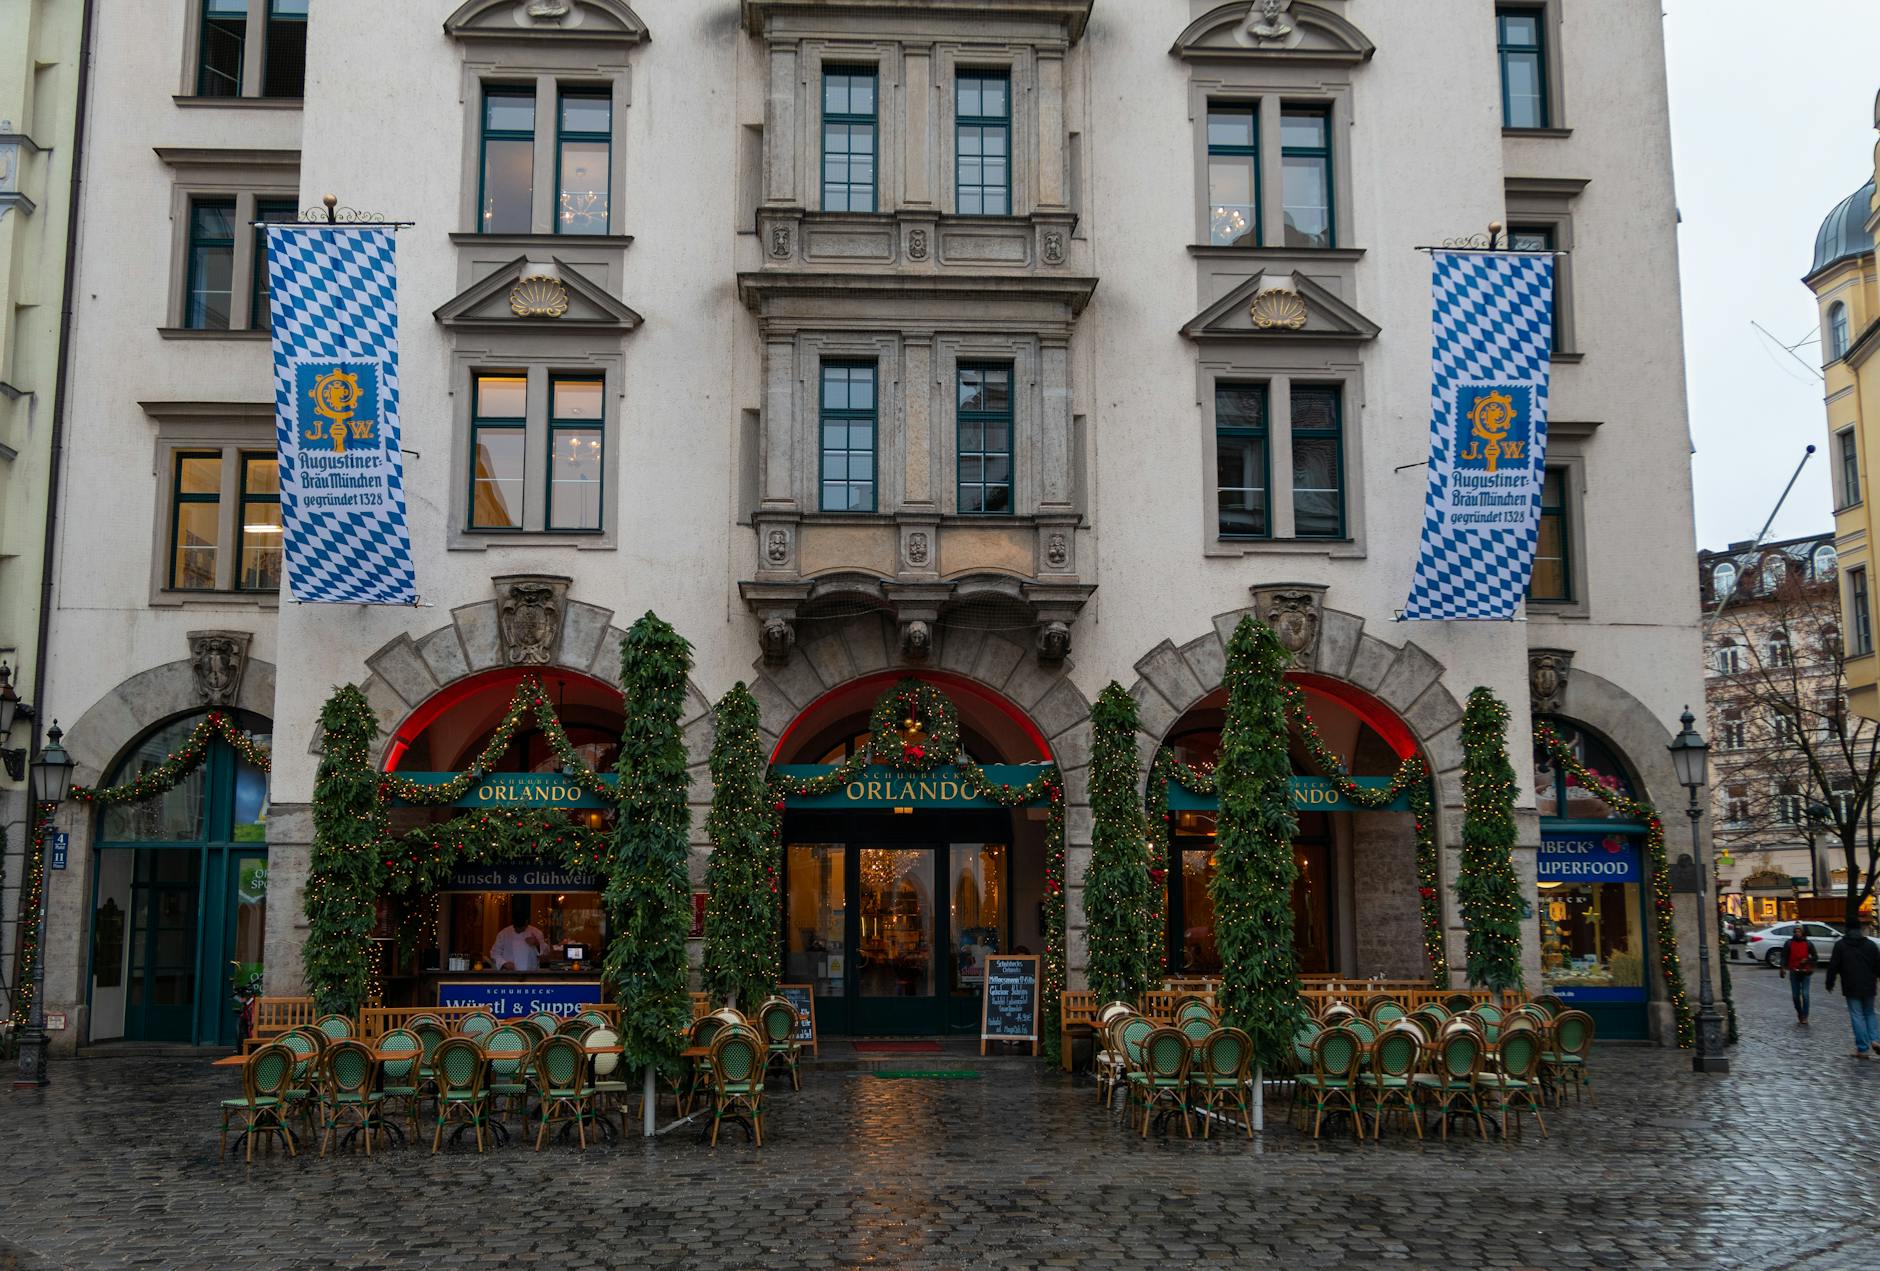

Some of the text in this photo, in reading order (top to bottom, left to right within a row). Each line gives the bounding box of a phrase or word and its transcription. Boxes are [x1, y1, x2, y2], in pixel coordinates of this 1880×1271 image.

[301, 471, 382, 489] Bräu München
[303, 492, 384, 508] gegründet 1328
[1452, 489, 1527, 507] Bräu München
[1451, 510, 1525, 525] gegründet 1328
[478, 785, 582, 801] ORLANDO
[846, 781, 979, 801] ORLANDO
[1294, 788, 1340, 804] NDO
[57, 834, 64, 843] 4
[54, 853, 64, 861] 11
[508, 873, 519, 885] &
[523, 870, 598, 885] Glühwein
[512, 1002, 524, 1014] &
[530, 999, 592, 1018] Suppe
